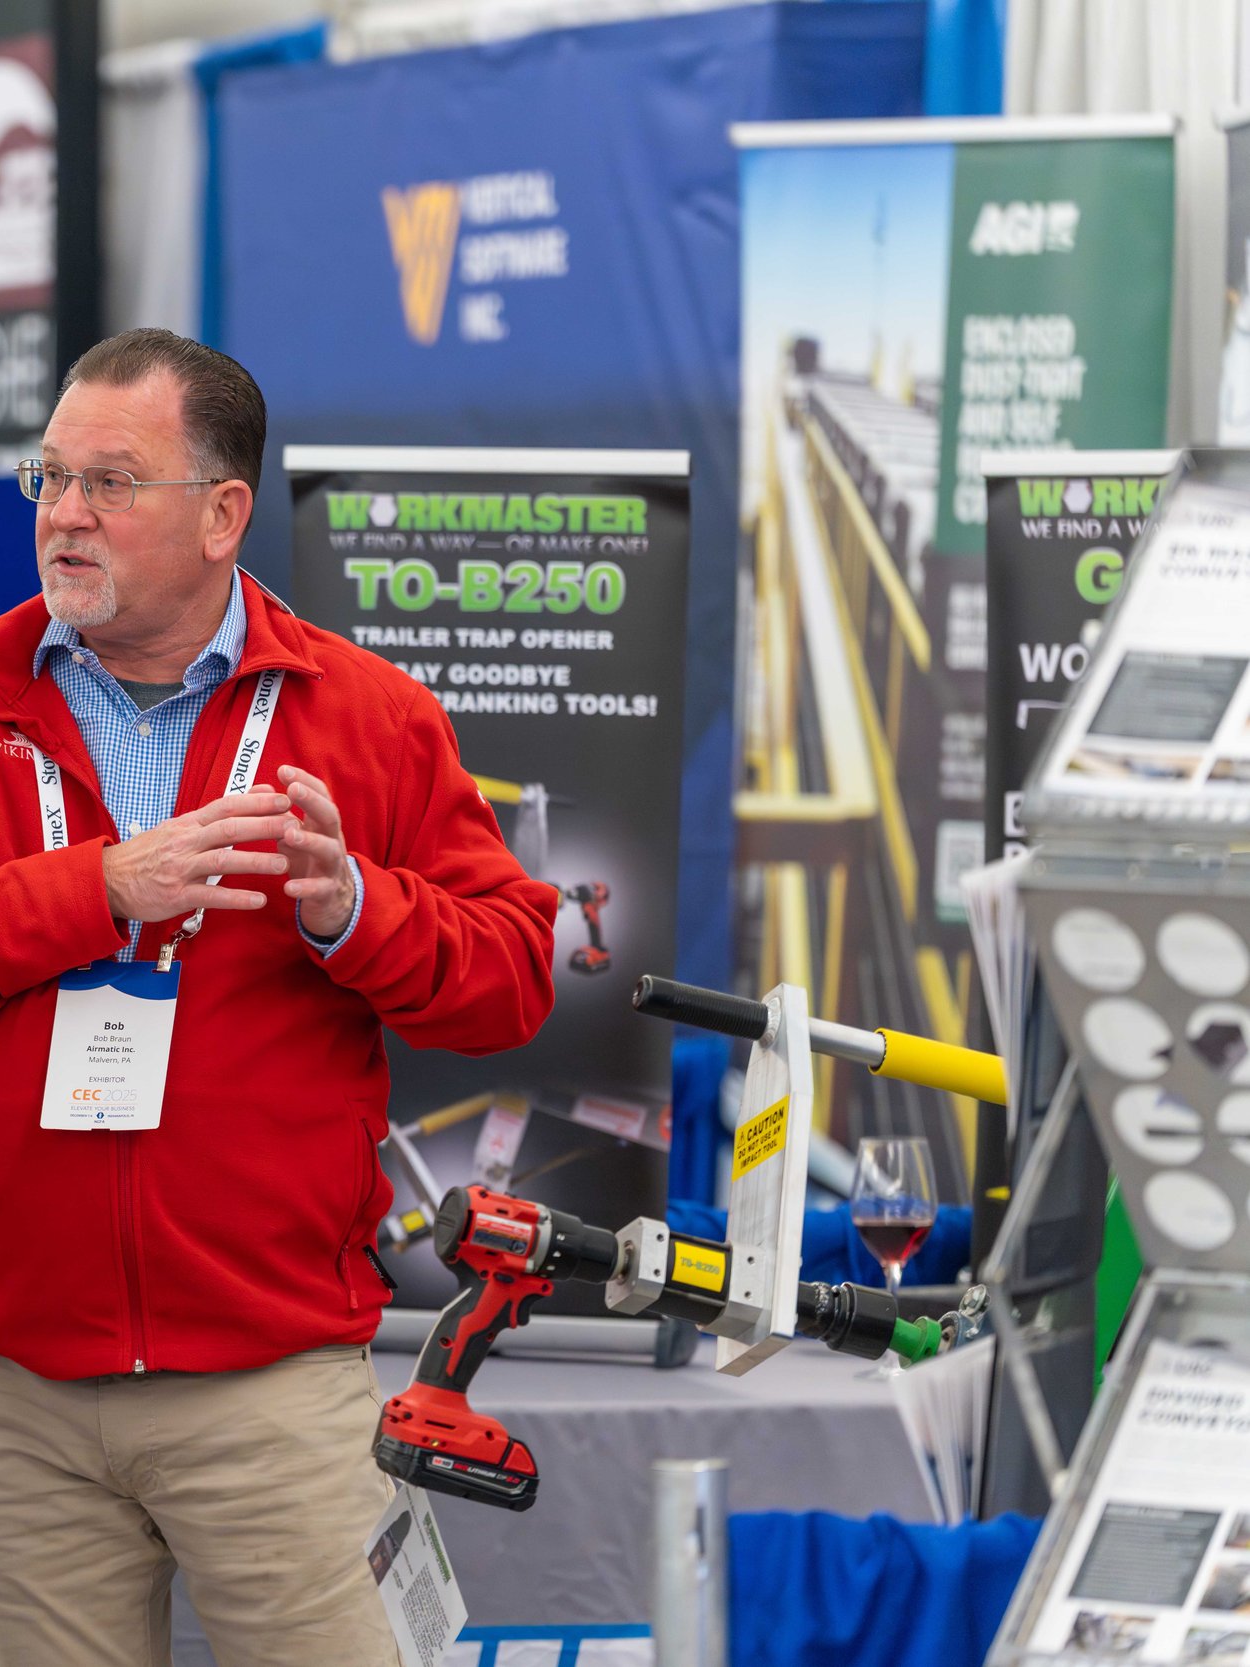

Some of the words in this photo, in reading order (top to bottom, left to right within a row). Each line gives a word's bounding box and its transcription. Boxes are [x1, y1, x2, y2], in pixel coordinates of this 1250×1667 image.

[1017, 478, 1161, 518] WORK
[325, 491, 647, 534] WORKMASTER
[1021, 518, 1053, 539] WE
[1057, 518, 1103, 539] FIND
[1107, 518, 1122, 539] A
[344, 558, 626, 615] TO-B250
[352, 625, 450, 647] TRAILER
[455, 627, 516, 649] TRAP
[520, 628, 614, 650] OPENER
[448, 663, 571, 687] GOODBYE
[563, 693, 658, 717] TOOLS!
[230, 738, 260, 794] StoneX
[104, 1021, 125, 1030] Bob
[86, 1045, 120, 1053] Airmatic
[110, 1035, 132, 1043] Braun
[88, 1056, 120, 1065] Malvern,
[88, 1076, 126, 1084] EXHIBITOR
[747, 1106, 785, 1142] CAUTION
